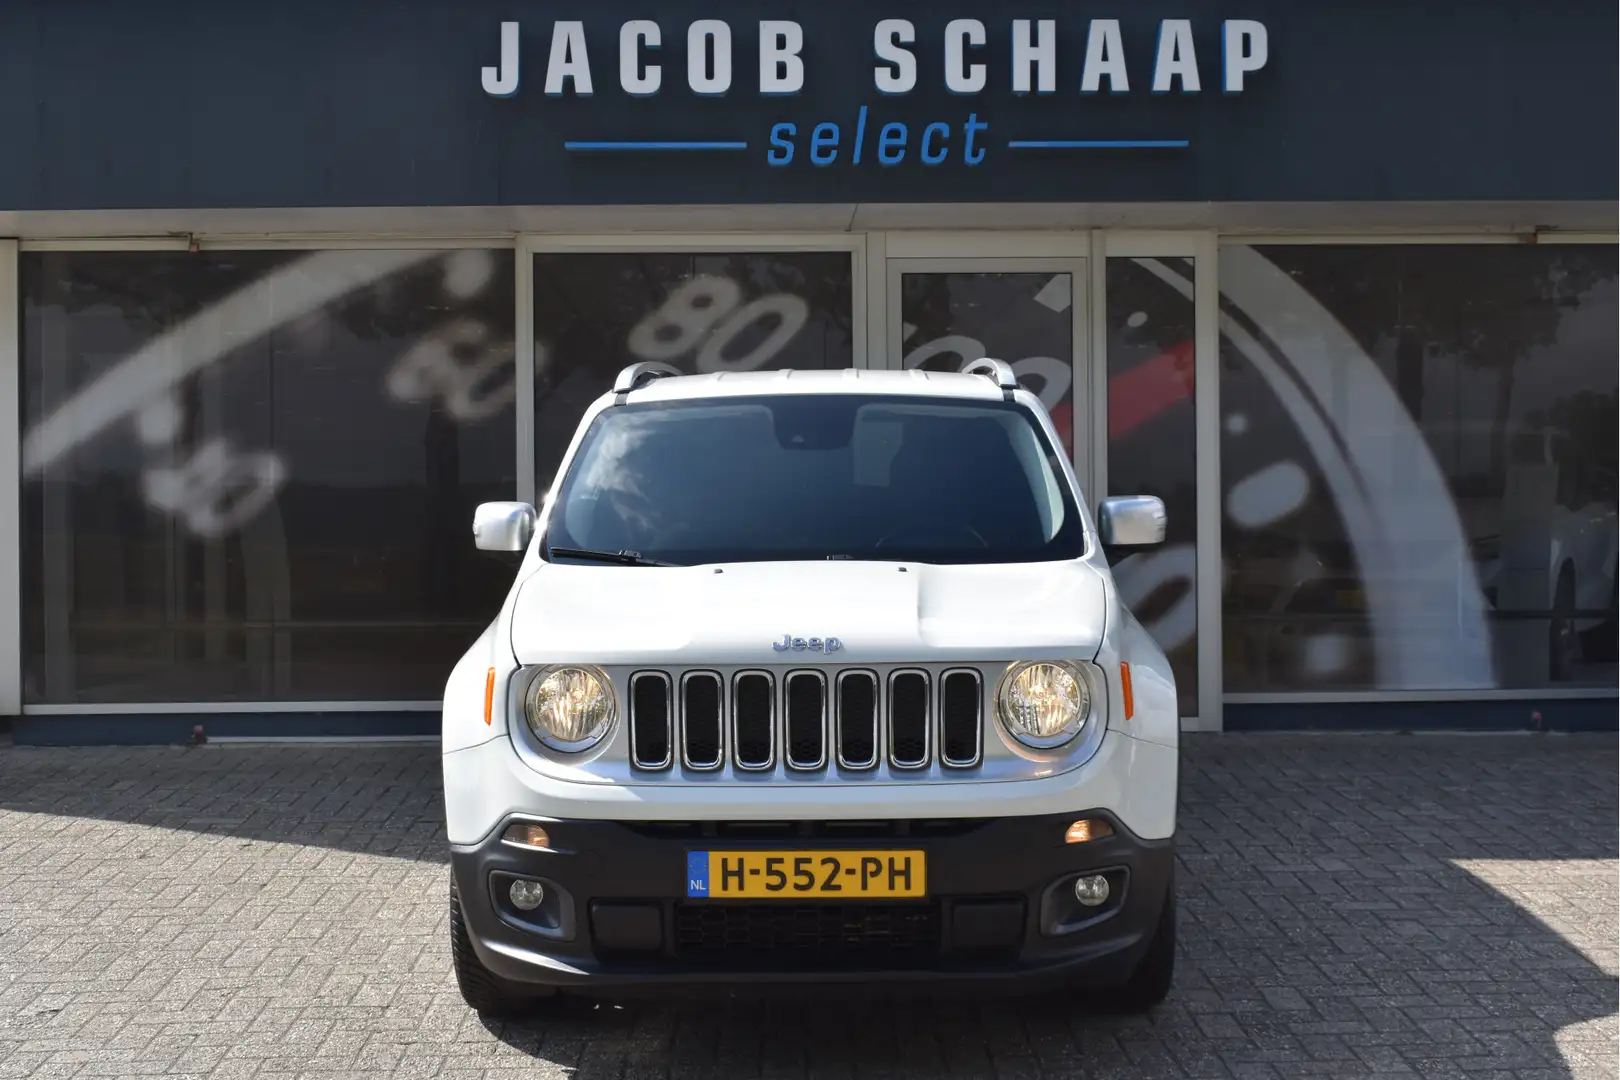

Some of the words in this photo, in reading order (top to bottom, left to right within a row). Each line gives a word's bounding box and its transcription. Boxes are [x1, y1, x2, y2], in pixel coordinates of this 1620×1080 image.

[481, 19, 805, 96] JACOB
[873, 18, 1269, 95] SCHAAP
[766, 105, 989, 167] select
[628, 274, 808, 373] 80
[772, 634, 842, 655] Jeep
[690, 879, 706, 890] NL
[721, 857, 912, 891] H-552-PH
